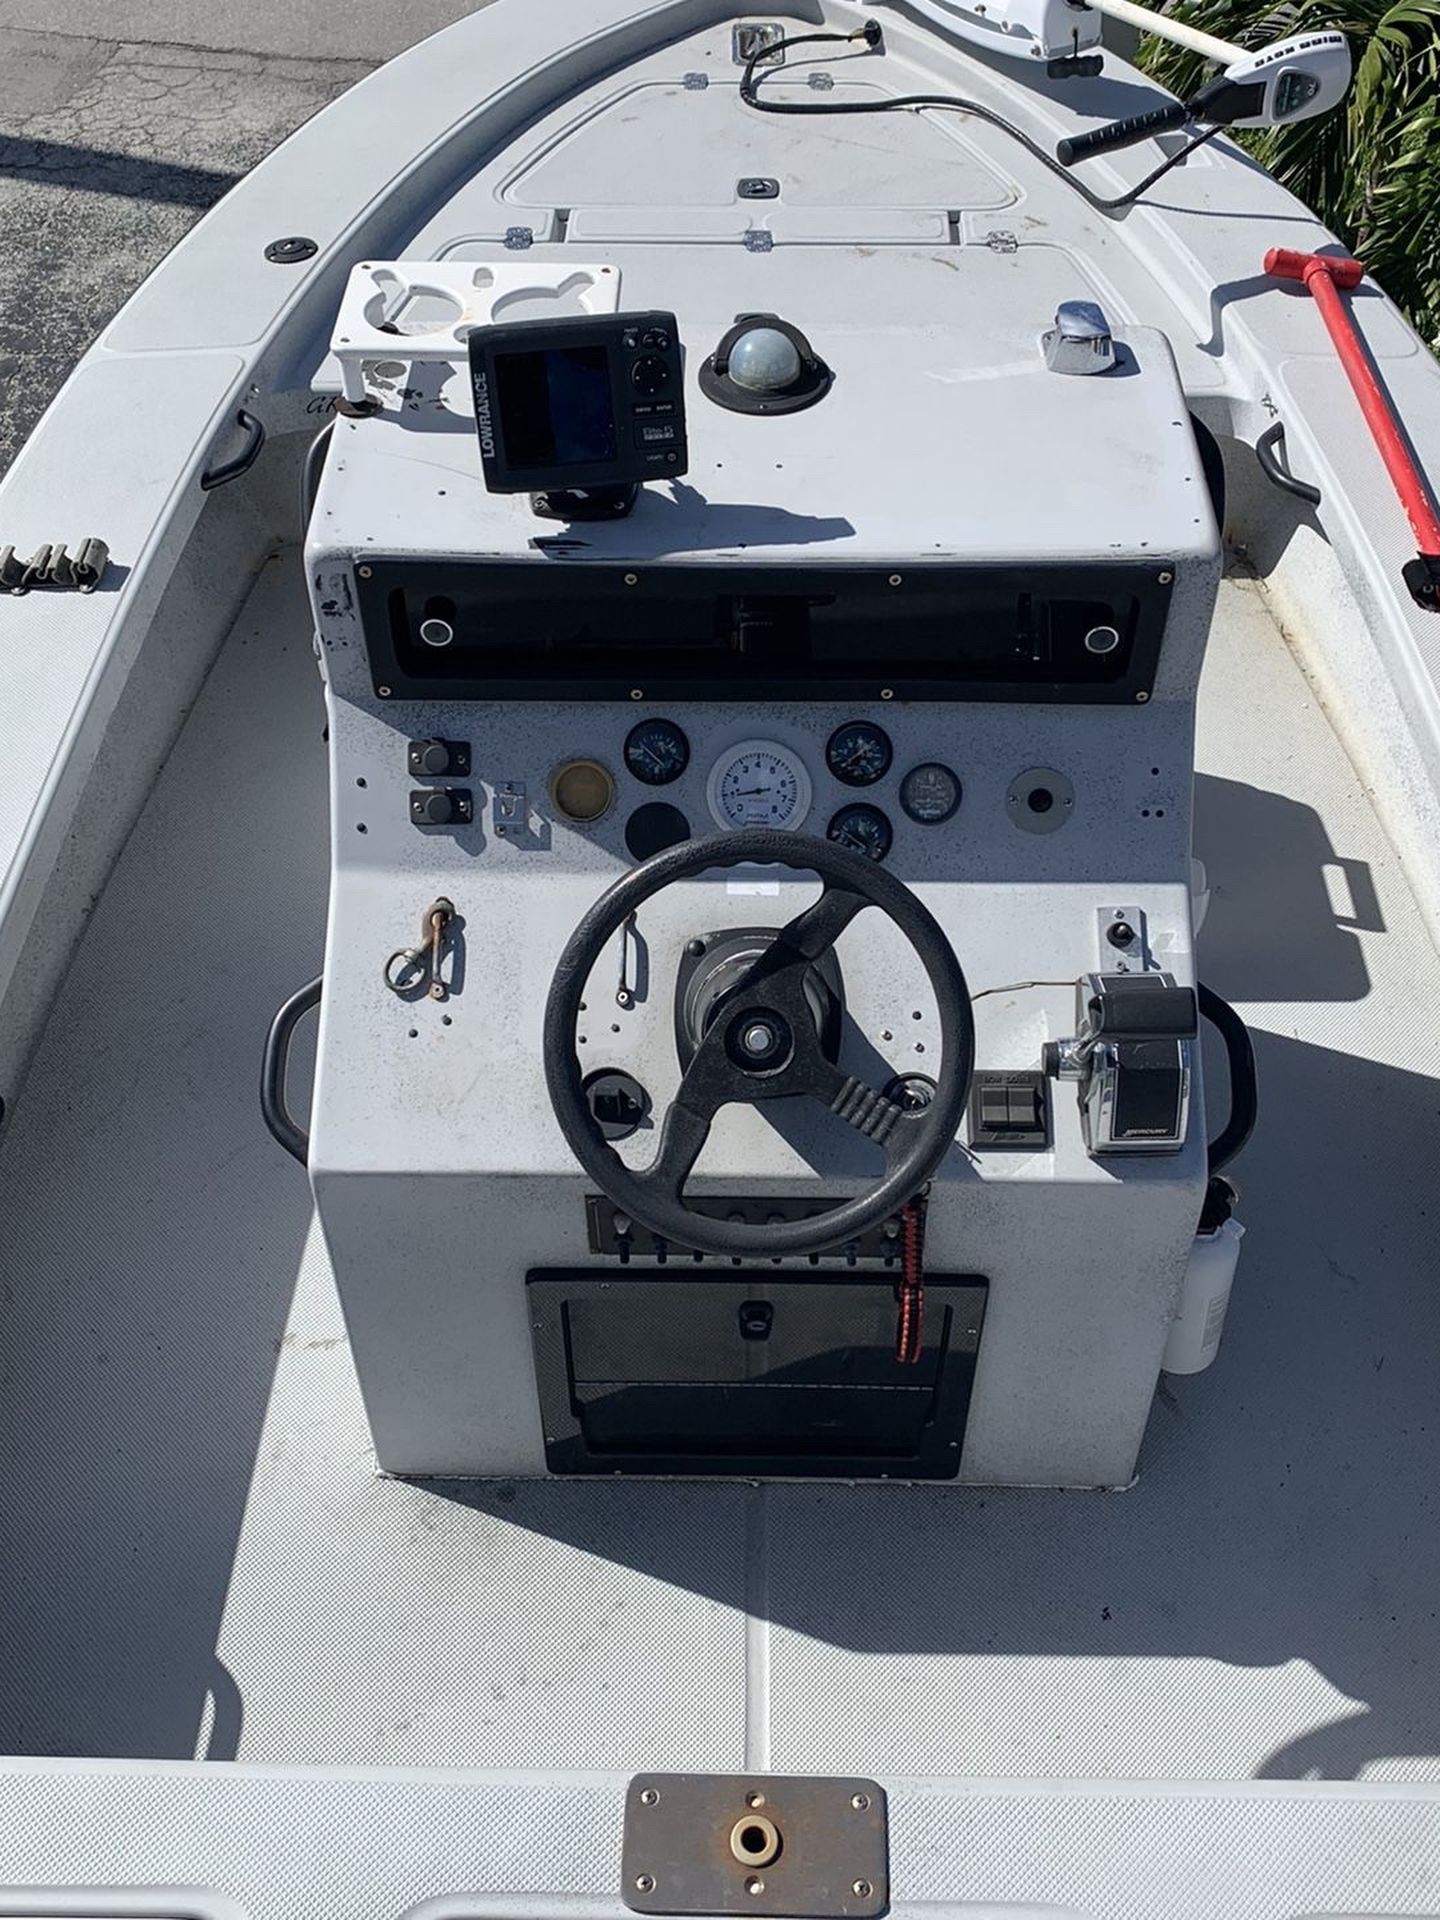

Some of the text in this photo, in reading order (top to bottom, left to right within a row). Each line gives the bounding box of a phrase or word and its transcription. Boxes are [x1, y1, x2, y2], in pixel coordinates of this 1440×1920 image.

[1253, 36, 1343, 68] MINN KOTA
[474, 372, 495, 459] LOWRANCE
[736, 803, 744, 812] 0
[771, 804, 778, 814] 8
